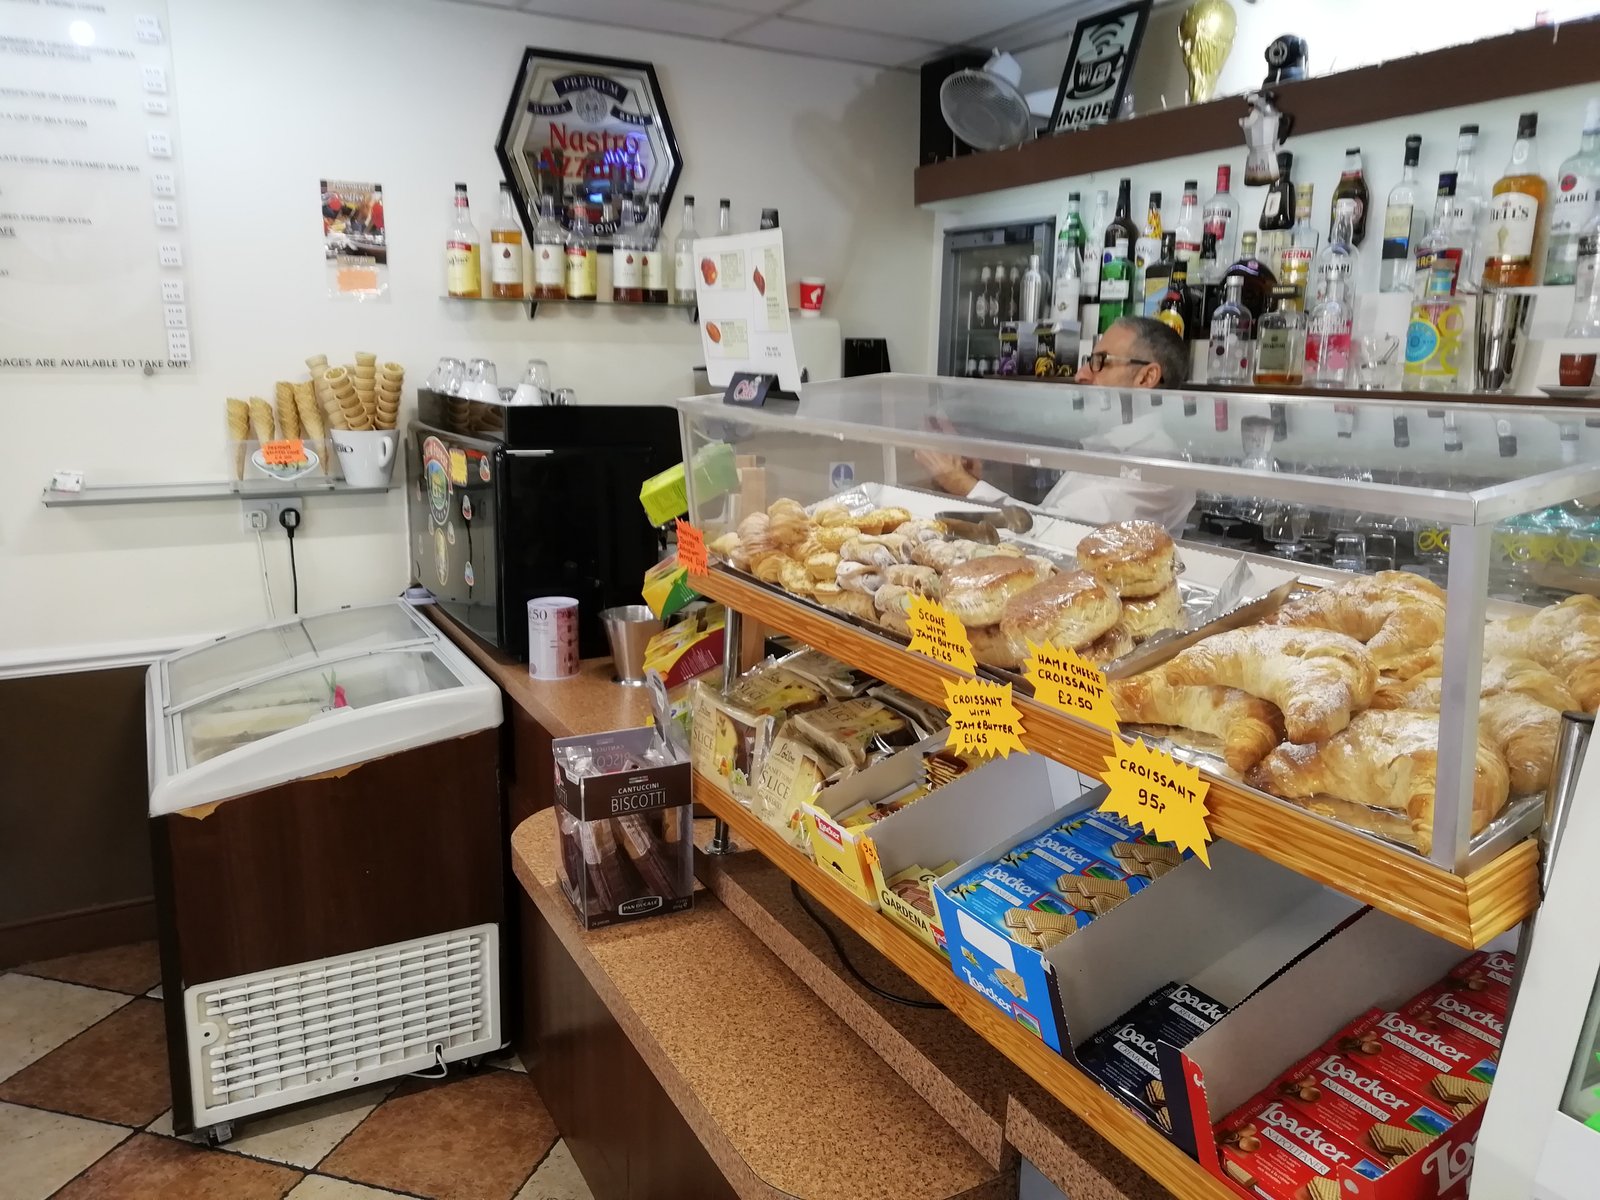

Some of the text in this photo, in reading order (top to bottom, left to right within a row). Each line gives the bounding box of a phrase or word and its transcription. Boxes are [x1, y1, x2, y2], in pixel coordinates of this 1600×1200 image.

[563, 75, 619, 97] PREMIUM
[1057, 101, 1114, 128] INSIDE
[549, 122, 640, 153] Nastro
[1490, 205, 1530, 222] BELL'S
[35, 358, 57, 368] ARE
[60, 358, 118, 369] AVAILABLE
[121, 359, 136, 368] TO
[138, 359, 164, 369] TAKE
[918, 608, 947, 629] SCONE
[925, 624, 947, 638] WITH
[931, 645, 953, 662] £1.65
[1037, 653, 1061, 672] HAM
[1069, 662, 1102, 685] CHEESE
[1037, 668, 1105, 700] CROISSANT
[952, 694, 1003, 709] CROISSANT
[968, 708, 992, 717] WITH
[1058, 689, 1094, 712] £2.50
[964, 732, 989, 745] £1.65
[618, 781, 661, 796] CANTUCCINI
[758, 768, 791, 801] SLICE
[1119, 757, 1197, 805] CROISSANT
[610, 790, 667, 814] BISCOTTI
[1033, 832, 1092, 867] Loacker
[983, 863, 1041, 900] Loacker
[880, 889, 930, 933] GARDENA
[961, 965, 1012, 1015] Loacker
[1172, 1005, 1210, 1031] CREMKAK
[1440, 1013, 1501, 1049] NAPOLITANE
[1376, 1011, 1472, 1064] Loacker
[1386, 1033, 1450, 1073] NAPOLITANER
[1117, 1043, 1162, 1077] CREMKAKAO
[1316, 1053, 1411, 1111] Loacker
[1324, 1078, 1388, 1121] NAPOLITANER
[1257, 1102, 1351, 1163] Loacker
[1264, 1129, 1329, 1174] NAPOLITANER
